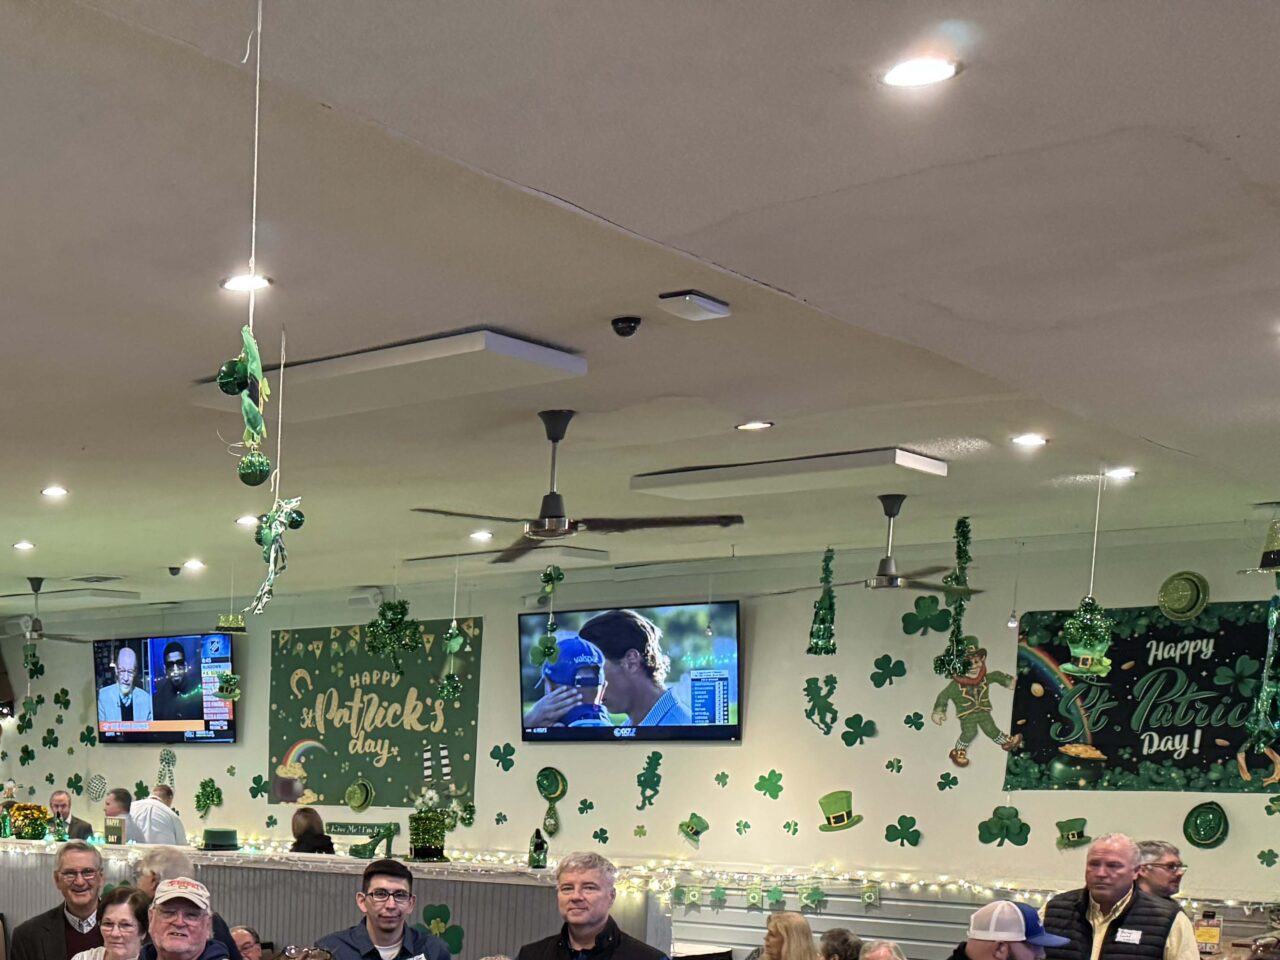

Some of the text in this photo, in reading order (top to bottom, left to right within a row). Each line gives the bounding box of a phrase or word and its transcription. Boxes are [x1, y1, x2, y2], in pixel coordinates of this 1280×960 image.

[1146, 638, 1215, 665] Happy
[350, 671, 401, 687] HAPPY
[314, 687, 445, 738] Patrick's
[1130, 666, 1249, 733] Patric
[349, 731, 392, 767] day
